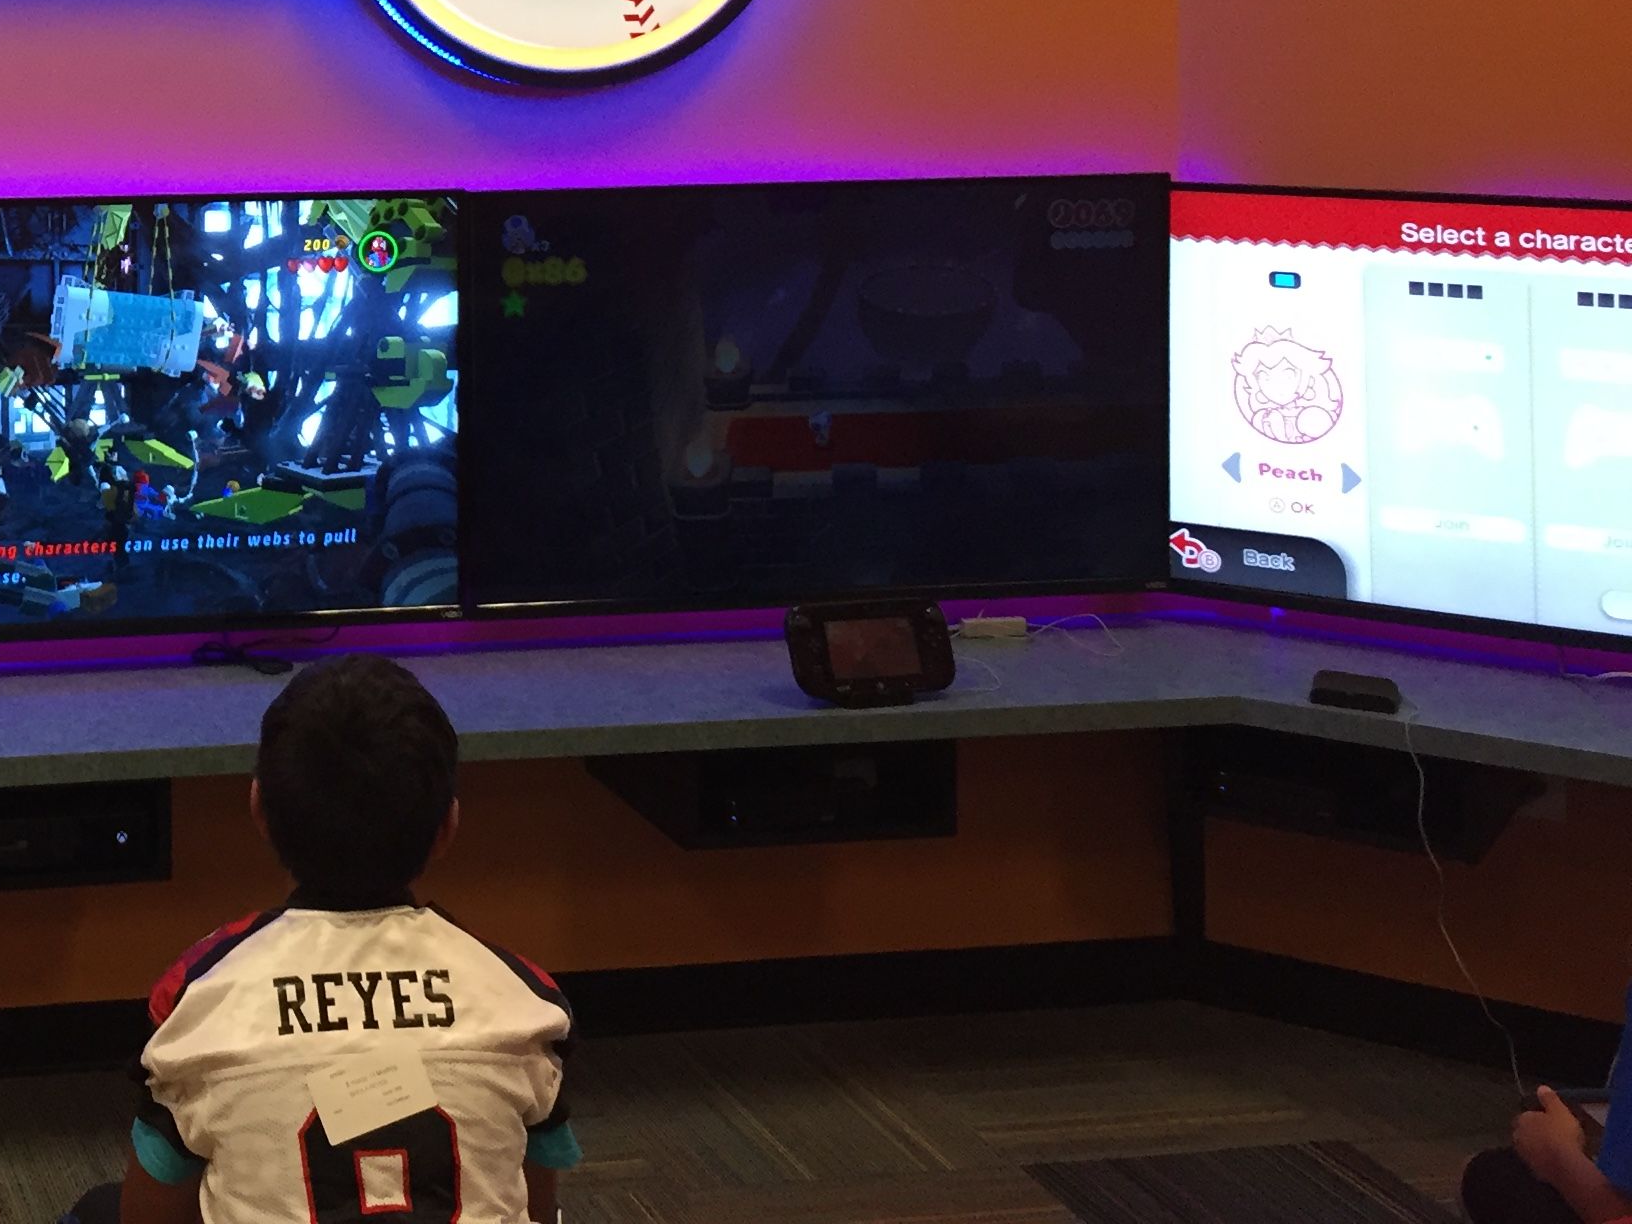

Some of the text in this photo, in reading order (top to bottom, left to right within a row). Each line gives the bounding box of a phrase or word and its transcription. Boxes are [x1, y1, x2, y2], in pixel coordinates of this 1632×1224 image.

[303, 239, 330, 251] 200
[1401, 222, 1487, 246] Select
[1494, 231, 1511, 247] a
[1258, 463, 1322, 482] Peach
[1291, 501, 1315, 515] OK
[24, 540, 117, 557] characters
[125, 539, 153, 553] can
[161, 537, 189, 551] use
[197, 533, 239, 549] their
[248, 531, 290, 546] webs
[299, 530, 315, 545] to
[323, 528, 357, 546] pull
[1243, 548, 1296, 571] Back
[273, 968, 457, 1037] REYES
